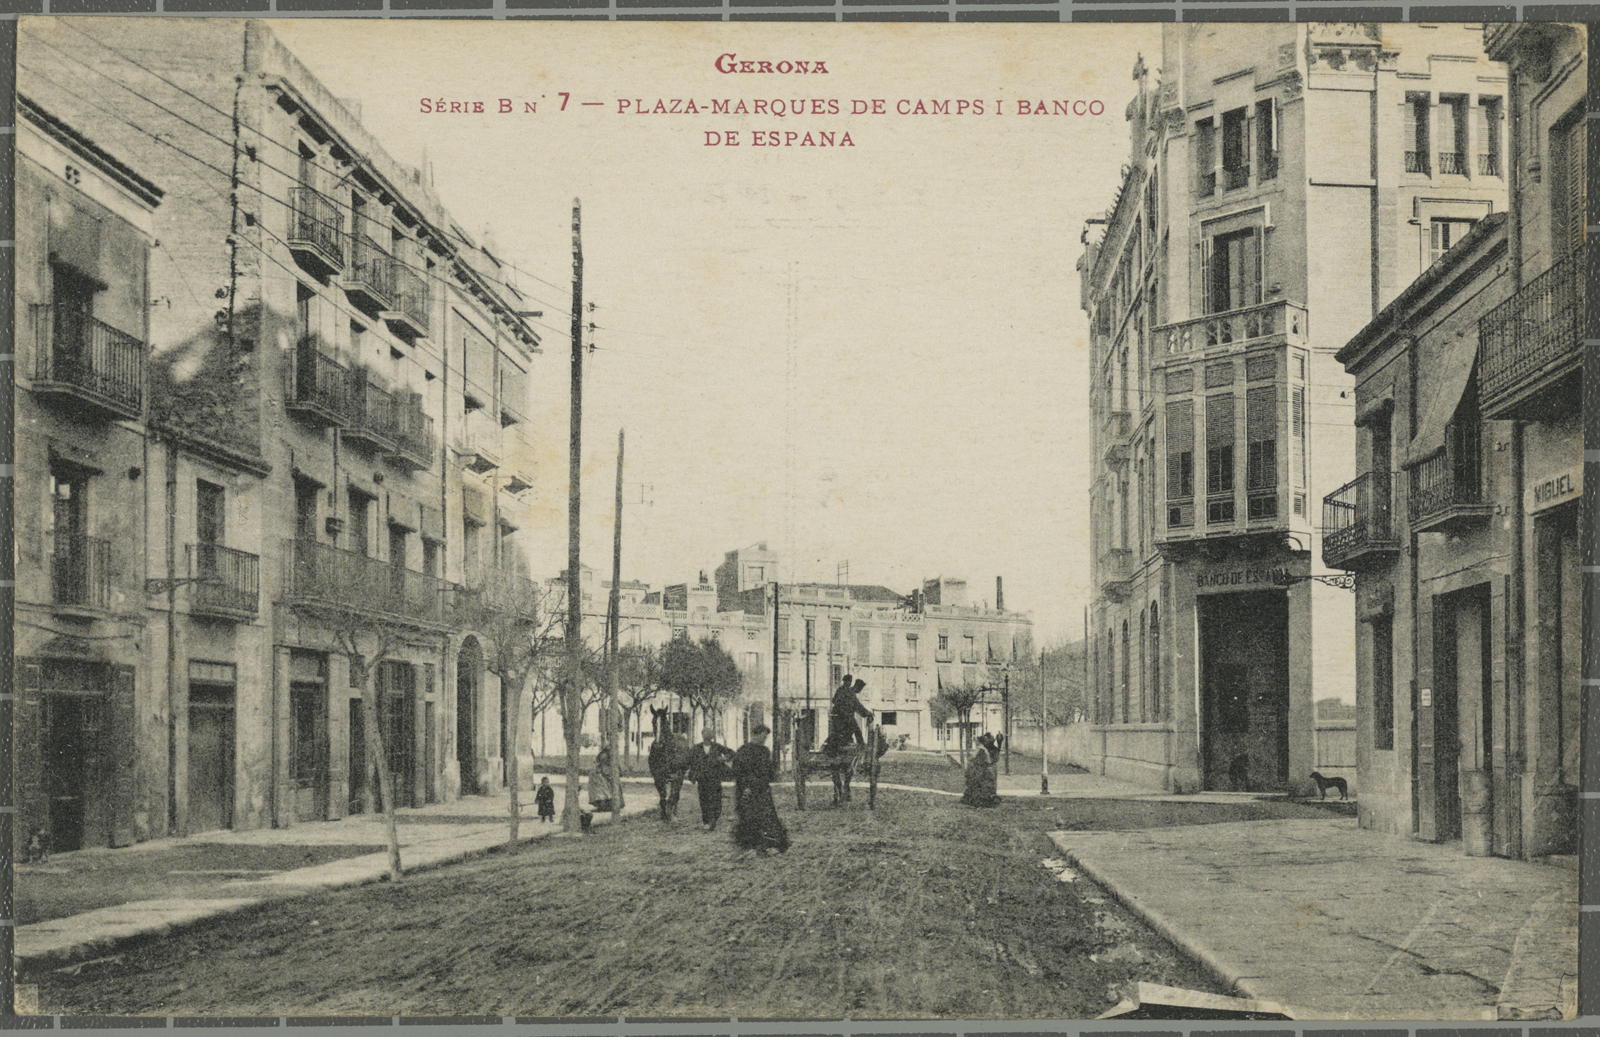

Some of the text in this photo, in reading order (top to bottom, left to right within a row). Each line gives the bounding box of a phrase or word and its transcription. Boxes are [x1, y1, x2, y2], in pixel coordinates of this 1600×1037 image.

[1534, 473, 1575, 503] MIGUEL
[1197, 572, 1229, 588] BANCO
[1230, 570, 1243, 585] DE
